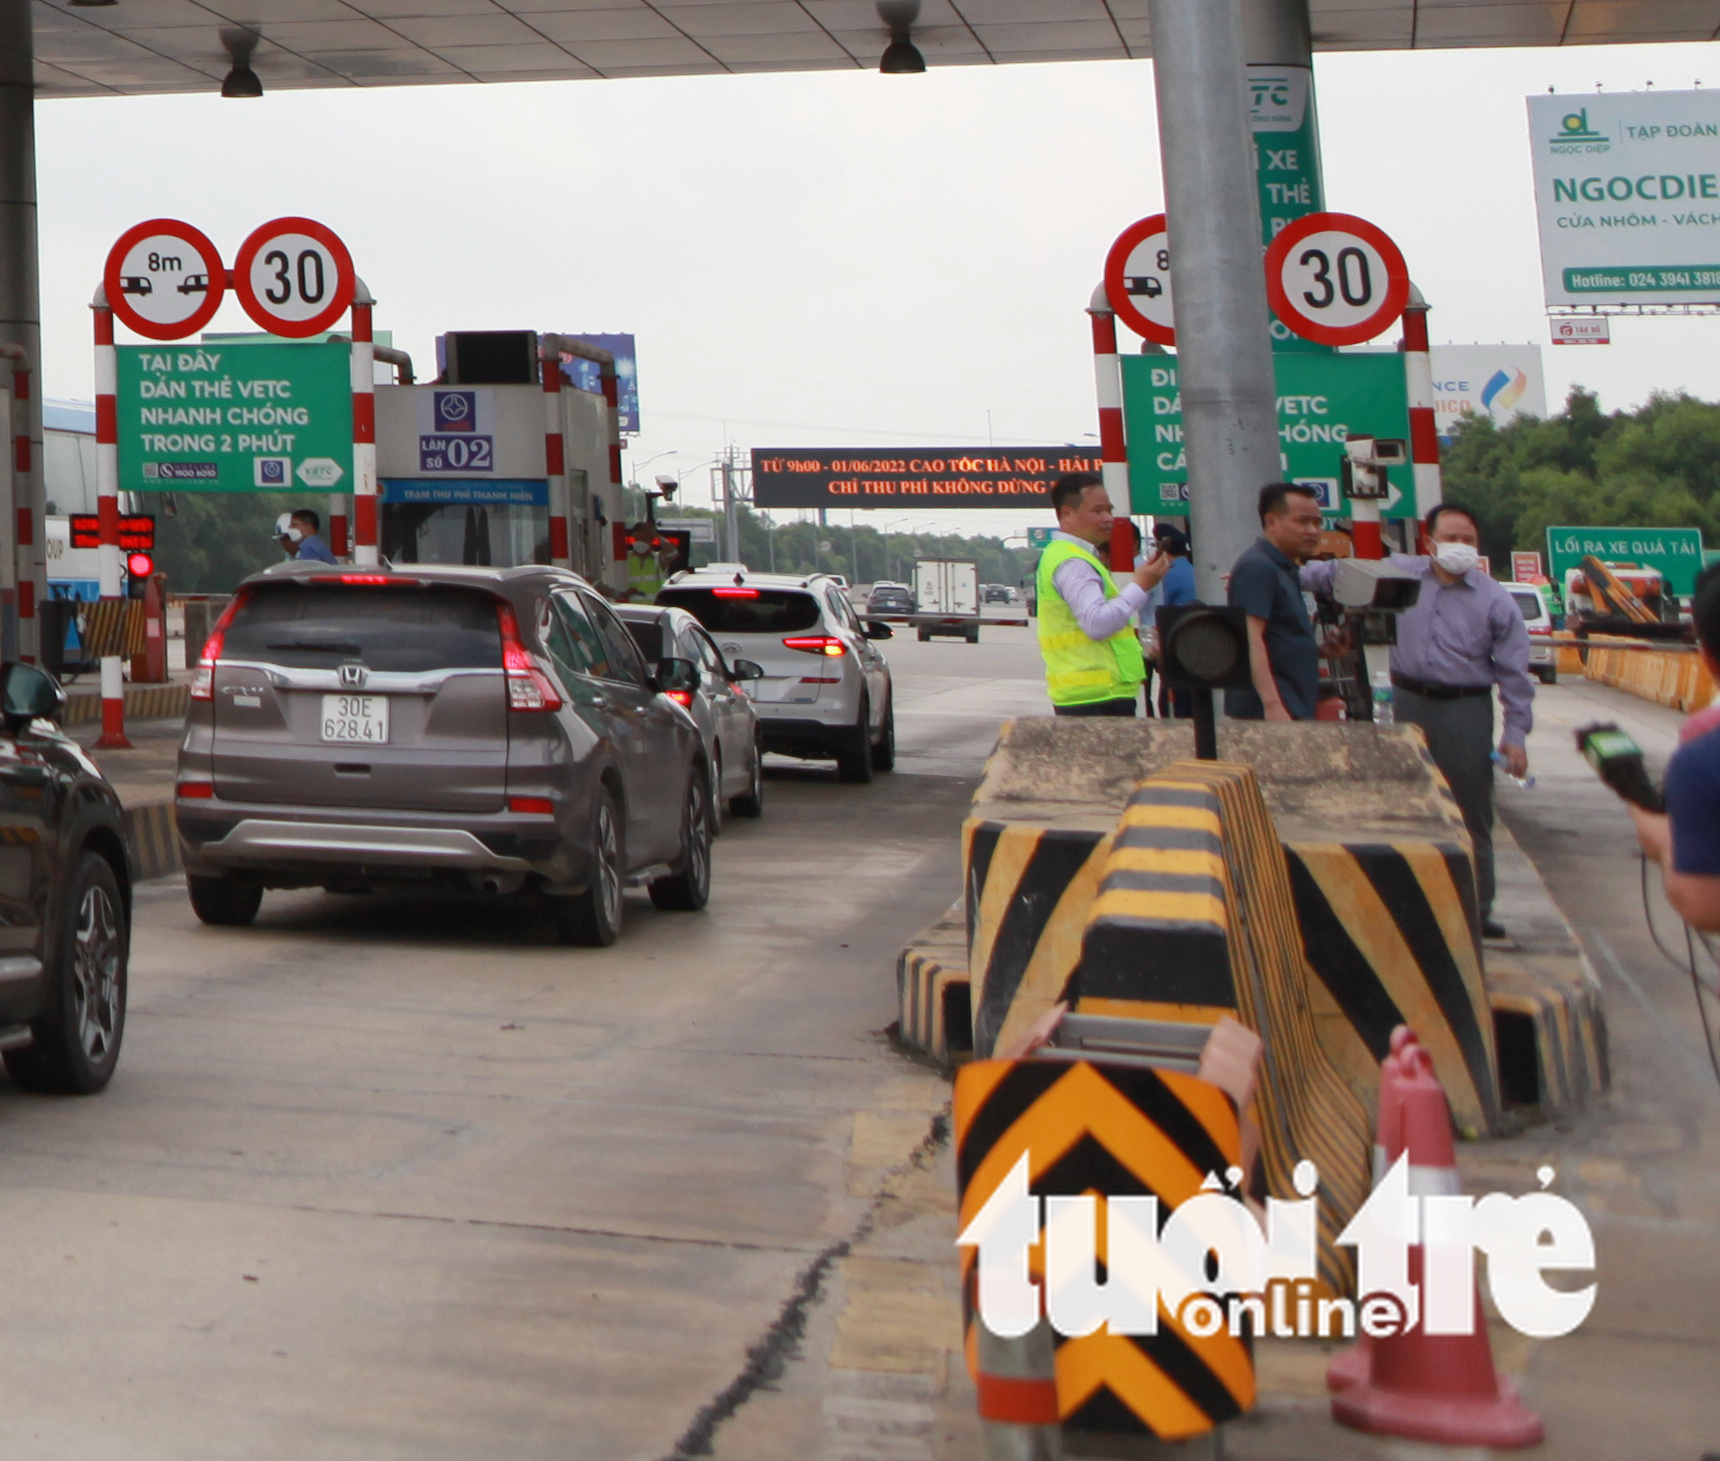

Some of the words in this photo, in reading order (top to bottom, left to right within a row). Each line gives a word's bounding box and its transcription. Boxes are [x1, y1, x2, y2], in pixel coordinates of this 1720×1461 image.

[1666, 120, 1718, 137] ĐOÀN
[1266, 149, 1298, 171] XE
[1557, 213, 1595, 228] CỬA
[1600, 211, 1657, 227] NHÔM
[147, 251, 183, 272] 8m
[264, 249, 325, 305] 30
[1299, 246, 1372, 309] 30
[1572, 272, 1626, 289] Hotline:
[1629, 272, 1656, 288] 024
[1659, 271, 1691, 287] 3941
[138, 353, 172, 376] TẠI
[177, 349, 222, 372] ĐÂY
[191, 374, 233, 398] THẺ
[236, 380, 292, 399] VETC
[140, 407, 222, 425] NHANH
[227, 402, 309, 425] CHÓNG
[140, 434, 215, 453] TRONG
[219, 434, 232, 453] 2
[238, 429, 296, 453] PHÚT
[422, 437, 446, 451] LÀN
[447, 438, 490, 467] 02
[426, 453, 442, 469] SỐ
[761, 456, 785, 473] TỪ
[787, 459, 821, 473] 9h00
[831, 459, 907, 473] 01/06/2022
[910, 459, 944, 473] CAO
[949, 455, 984, 473] TỐC
[987, 454, 1012, 473] HÀ
[1015, 455, 1047, 476] NỘI
[828, 478, 860, 495] CHỈ
[862, 480, 897, 495] THU
[900, 478, 929, 495] PHÍ
[932, 477, 995, 495] KHÔNG
[997, 477, 1048, 495] DỪNG
[1555, 535, 1581, 554] LỐI
[1584, 541, 1605, 554] RA
[1608, 541, 1629, 555] XE
[1631, 537, 1666, 555] QUÁ
[1671, 537, 1695, 555] TẢI
[337, 696, 373, 718] 30E
[324, 719, 385, 740] 628.41
